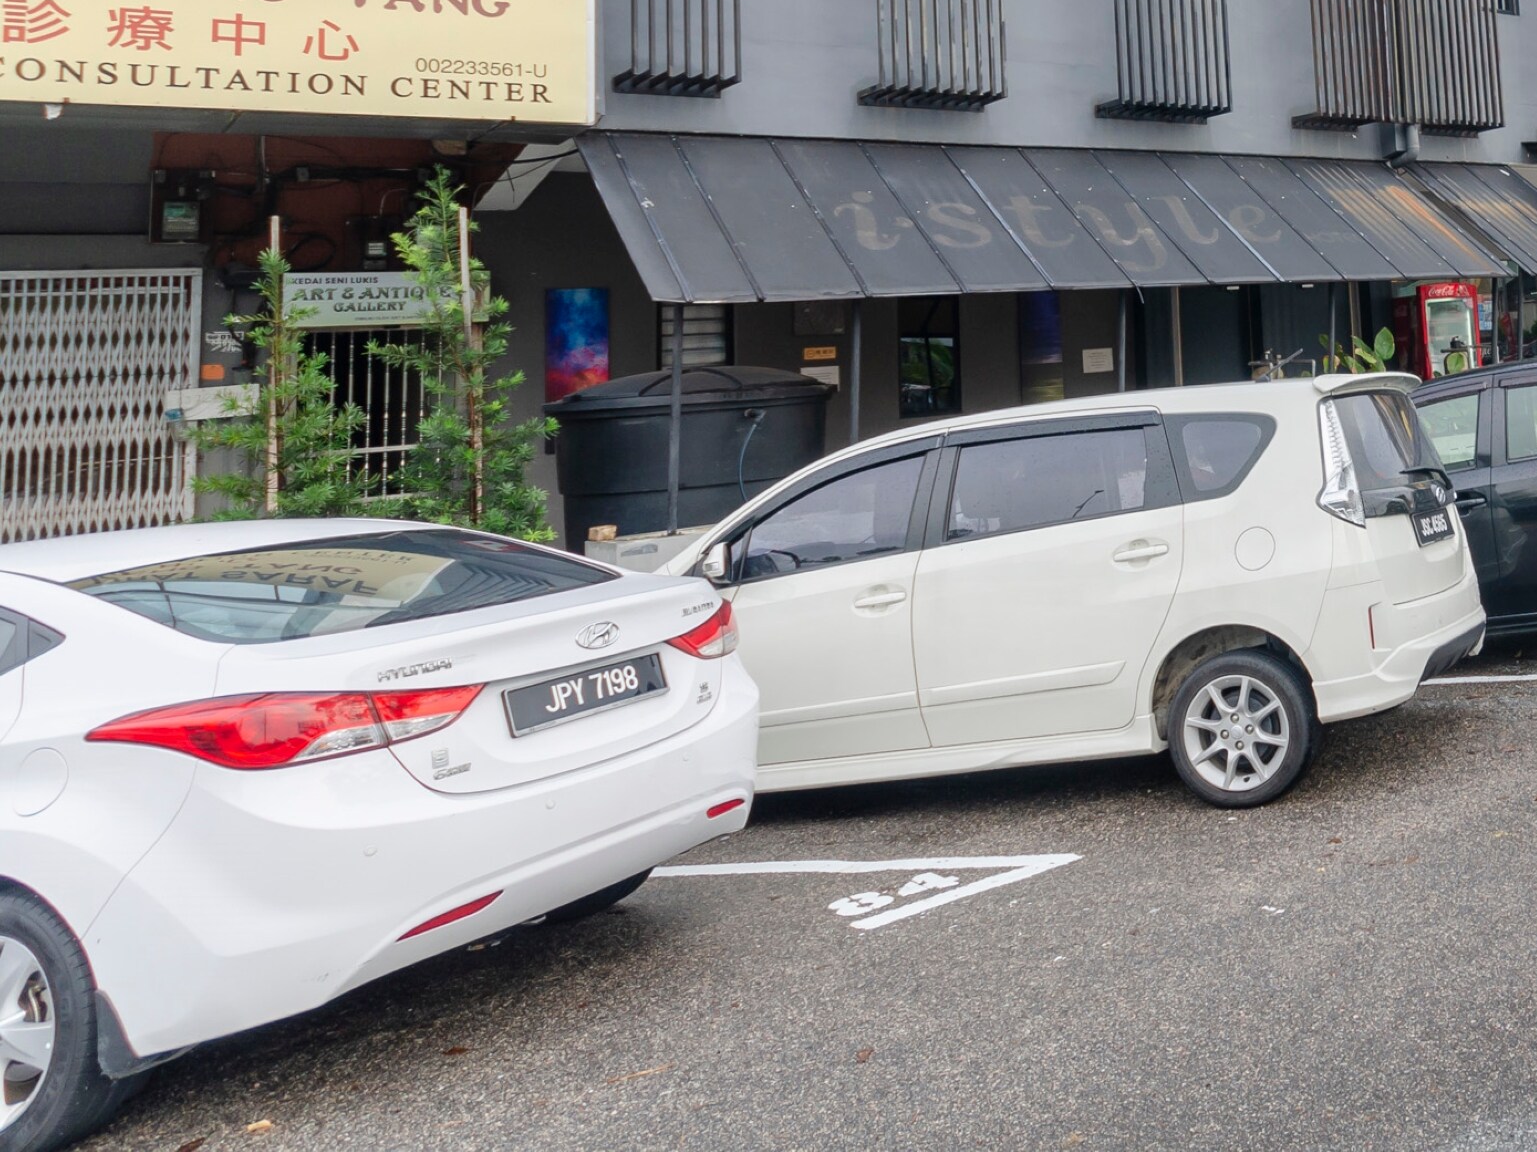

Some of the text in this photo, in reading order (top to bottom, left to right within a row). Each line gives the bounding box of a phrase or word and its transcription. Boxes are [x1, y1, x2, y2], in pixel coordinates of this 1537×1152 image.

[415, 56, 547, 78] 002233561-U
[0, 56, 552, 104] ONSULTATION CENTER
[350, 276, 378, 284] LUKIS
[292, 287, 337, 301] ART
[341, 287, 355, 300] &
[333, 301, 407, 313] GALLERY
[378, 658, 453, 682] HYUNDAI
[545, 665, 639, 713] JPY 7198
